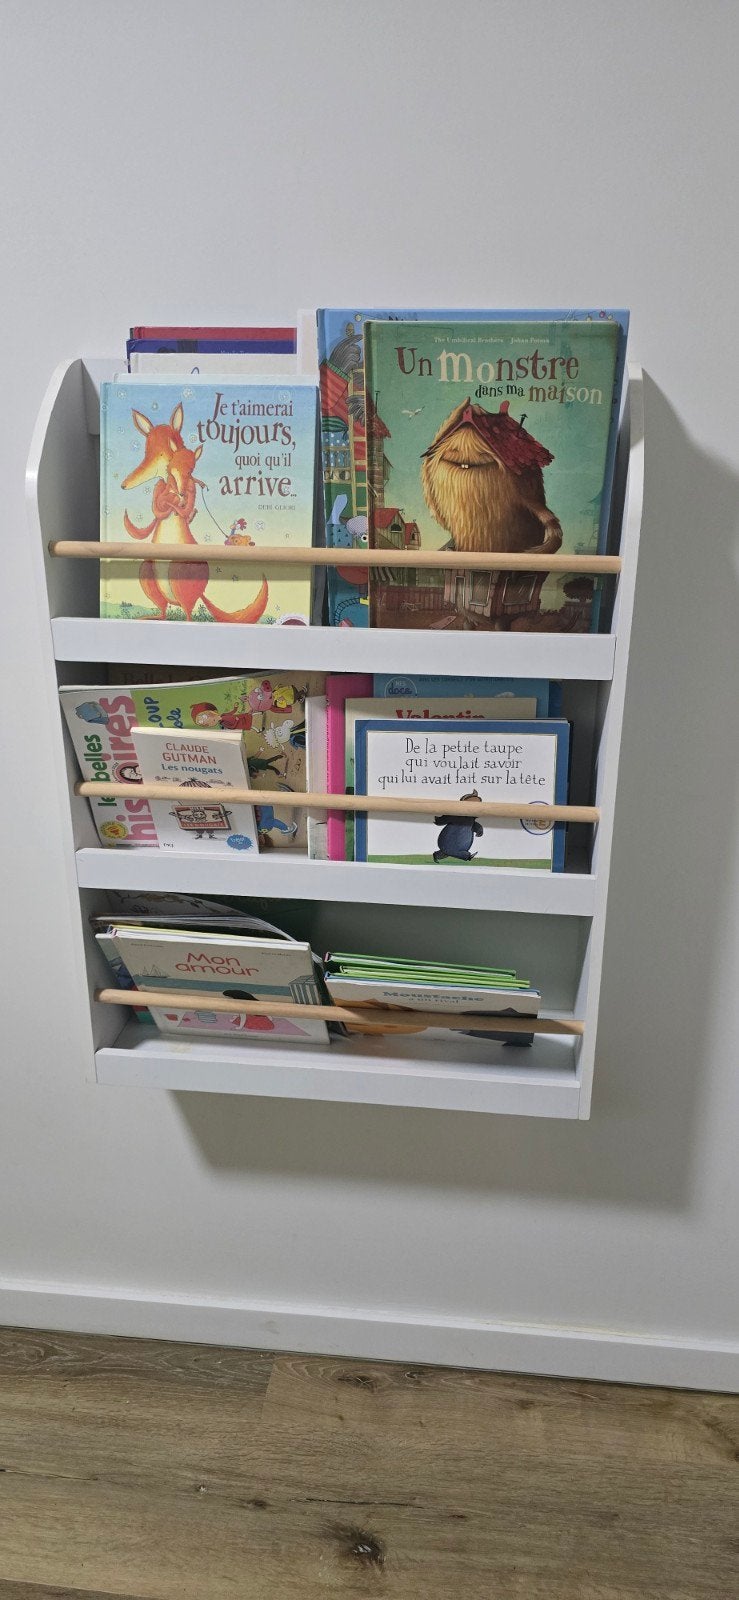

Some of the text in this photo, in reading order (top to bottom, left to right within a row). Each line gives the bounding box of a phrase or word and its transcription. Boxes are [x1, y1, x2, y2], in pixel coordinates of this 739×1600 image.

[394, 347, 579, 383] Un monstre
[475, 383, 602, 405] dans ma maison
[213, 392, 294, 421] Je t'aimerai
[196, 418, 296, 453] toujours,
[235, 453, 291, 472] quoi qu'il
[143, 696, 164, 728] OUP
[83, 734, 111, 782] belles
[165, 742, 209, 754] CLAUDE
[405, 738, 523, 759] De la petite taupe
[99, 695, 159, 841] hisoires
[162, 753, 217, 765] GUTMAN
[405, 757, 428, 773] qui
[483, 758, 522, 769] savoir
[181, 766, 223, 775] nougats
[377, 769, 547, 790] qui lui avait fait sur la tête
[175, 962, 260, 977] amour
[187, 952, 241, 968] Mon
